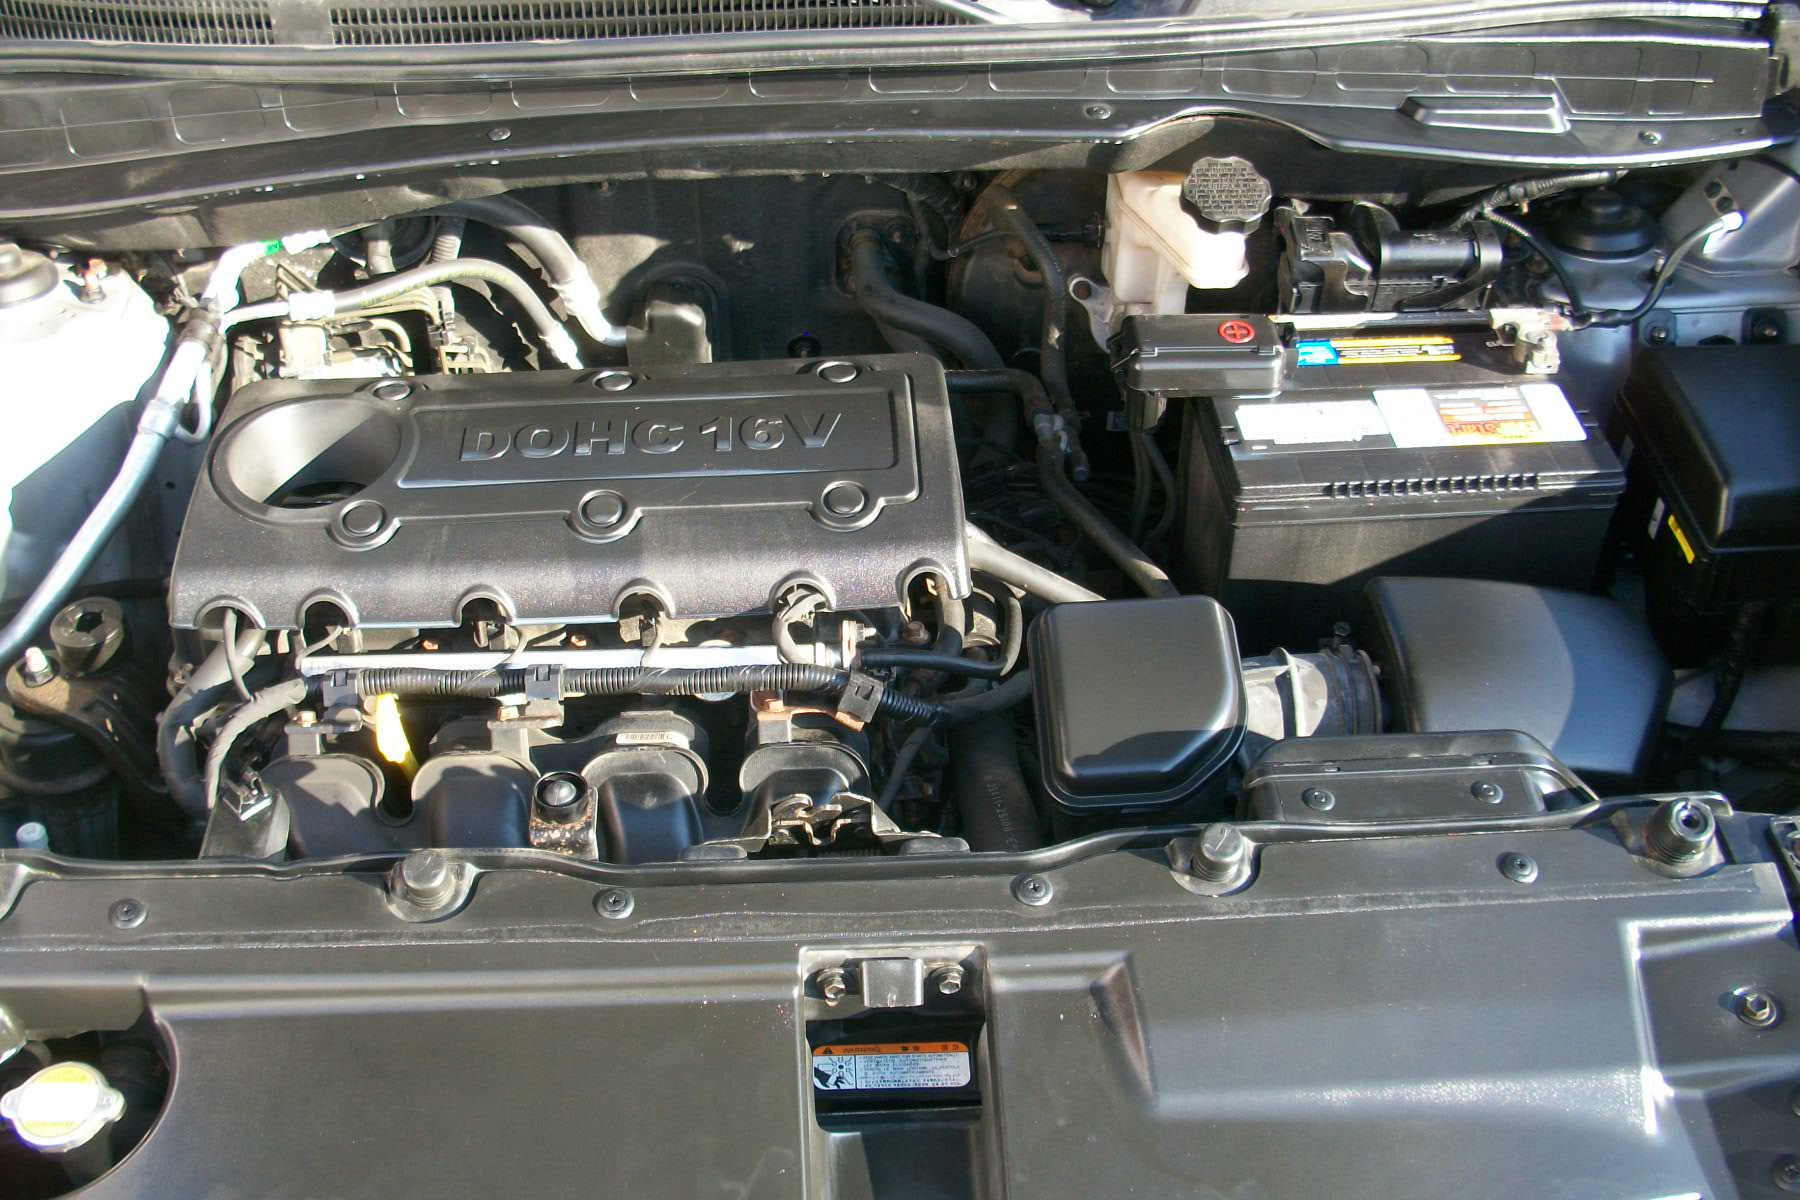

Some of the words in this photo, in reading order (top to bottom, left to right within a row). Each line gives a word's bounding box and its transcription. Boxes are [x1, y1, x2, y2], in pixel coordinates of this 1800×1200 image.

[460, 419, 685, 462] DOHC
[699, 412, 842, 453] 16V
[842, 1046, 880, 1054] WARNING
